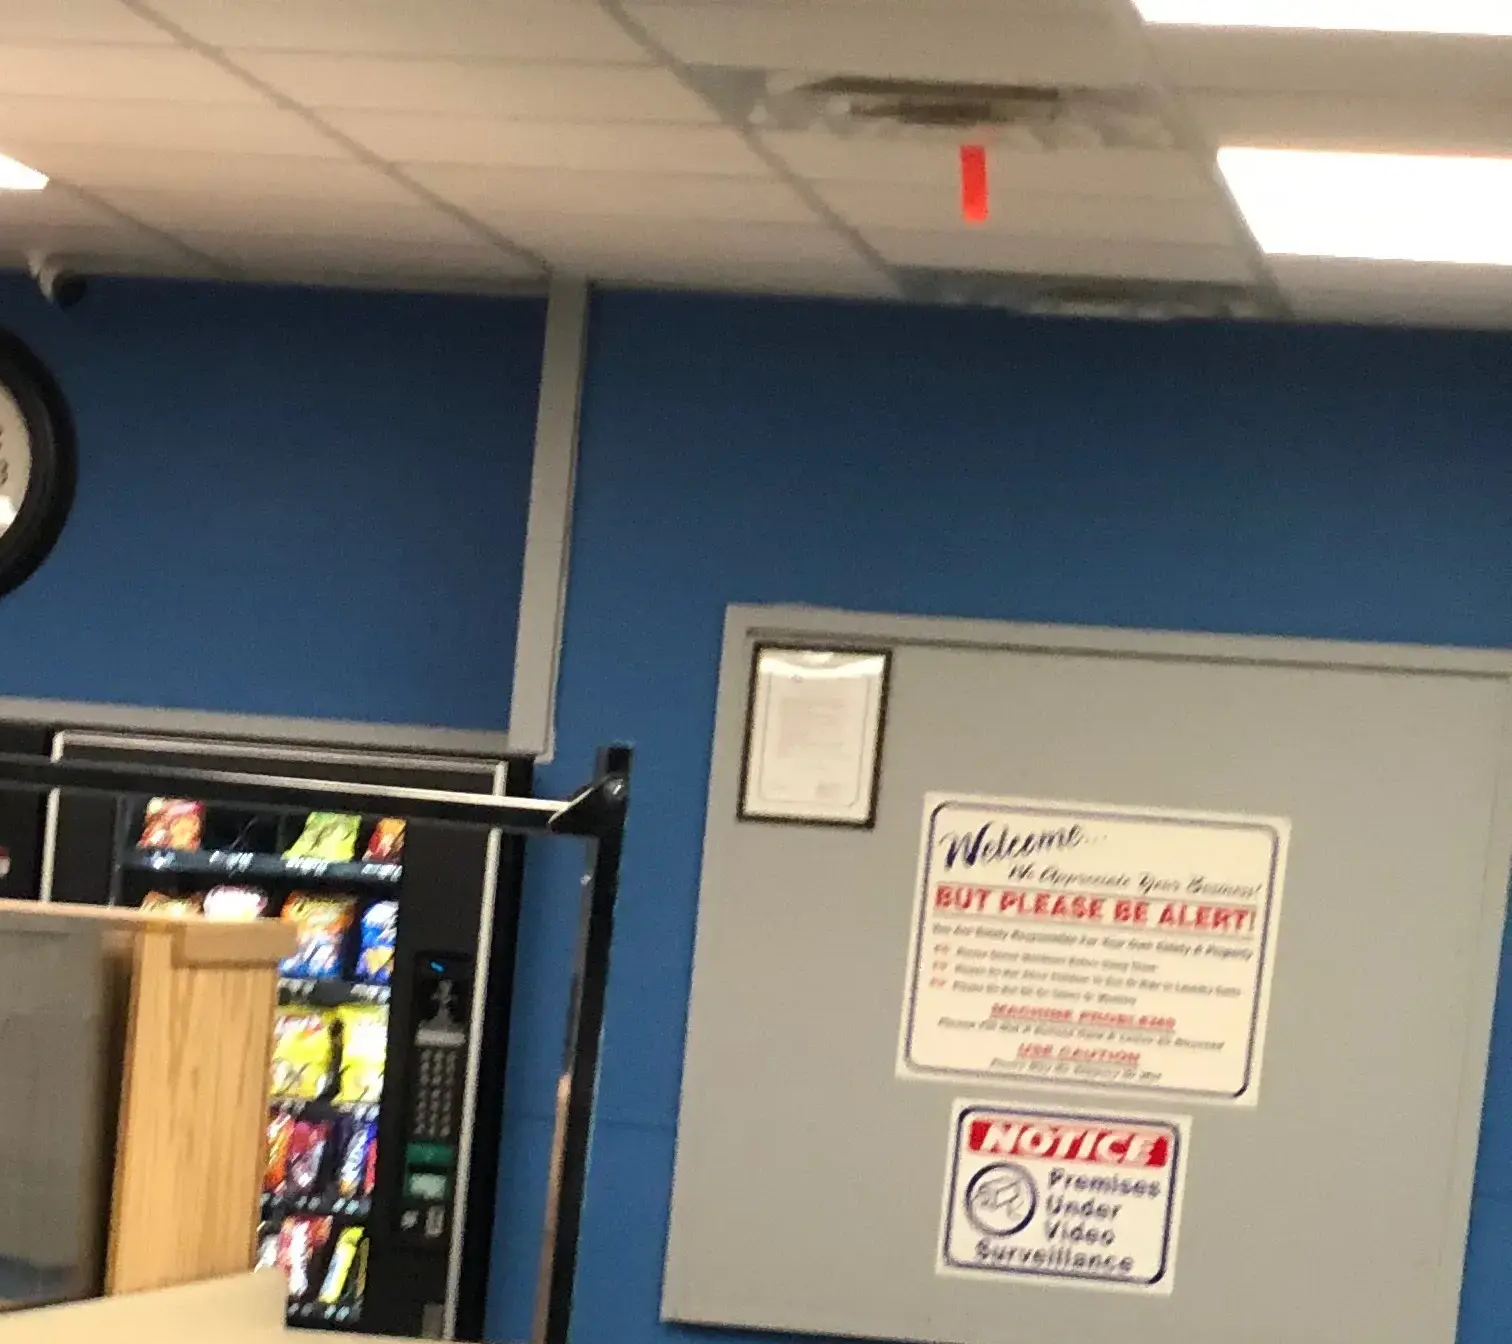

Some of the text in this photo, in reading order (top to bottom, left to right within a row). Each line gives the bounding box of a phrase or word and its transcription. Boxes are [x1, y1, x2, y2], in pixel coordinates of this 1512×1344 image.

[936, 882, 1257, 933] BUT PLEASE BE ALERT!
[981, 1122, 1155, 1164] NOTICE
[1049, 1167, 1161, 1199] Premises
[1047, 1196, 1122, 1218] Under
[1047, 1220, 1116, 1246] Video
[976, 1237, 1136, 1272] Surveillance
